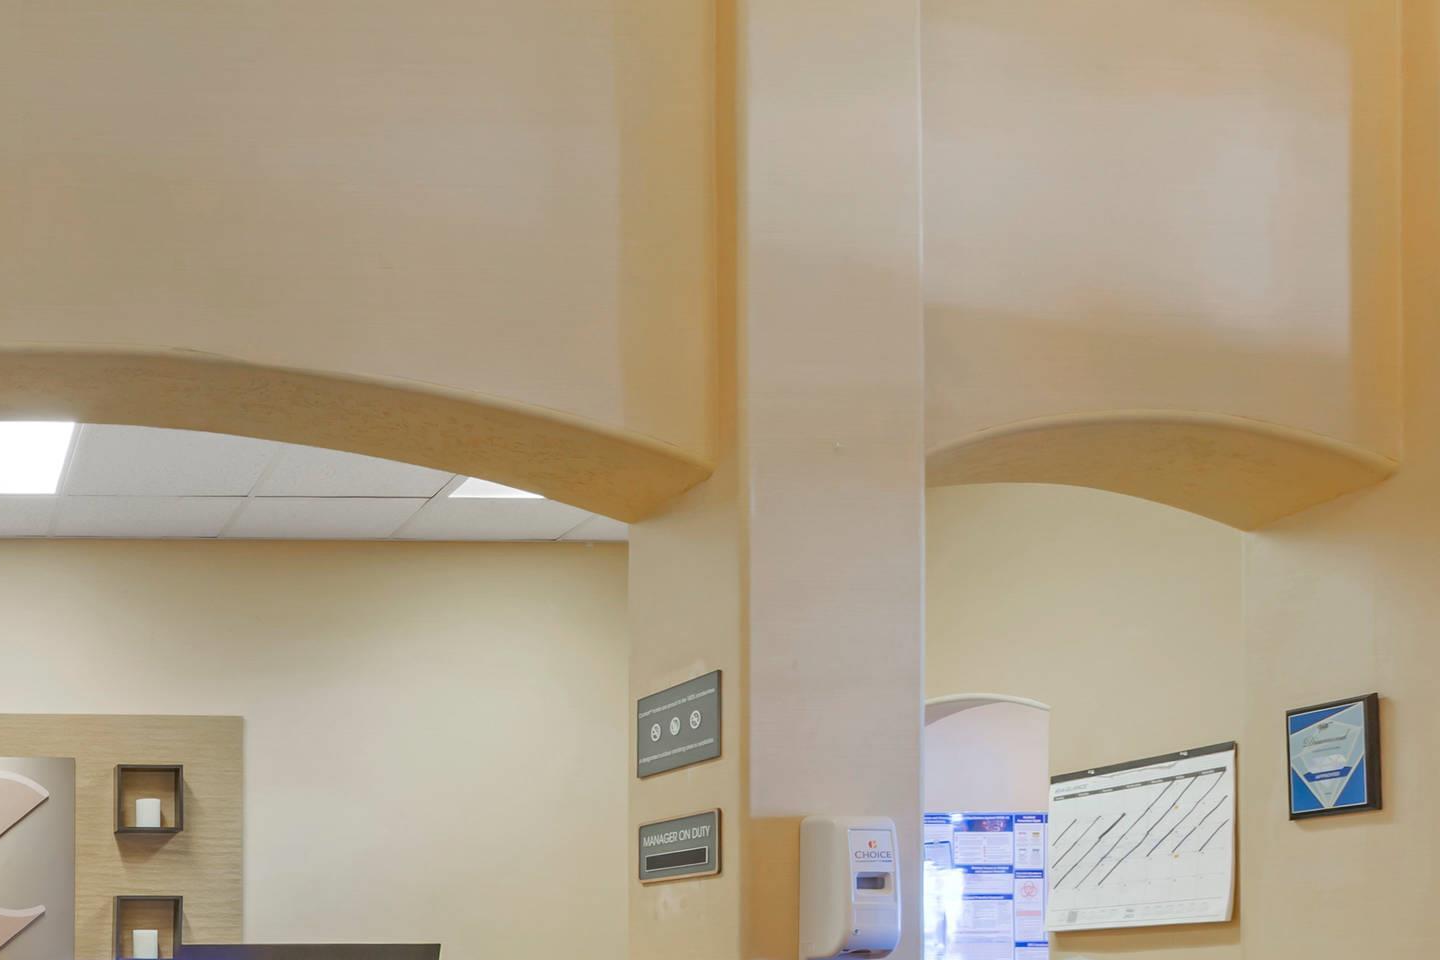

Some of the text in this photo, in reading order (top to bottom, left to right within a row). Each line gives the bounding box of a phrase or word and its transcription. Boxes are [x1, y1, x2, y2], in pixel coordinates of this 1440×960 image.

[643, 824, 711, 847] MANAGER ON DUTY
[854, 850, 893, 859] CHOICE
